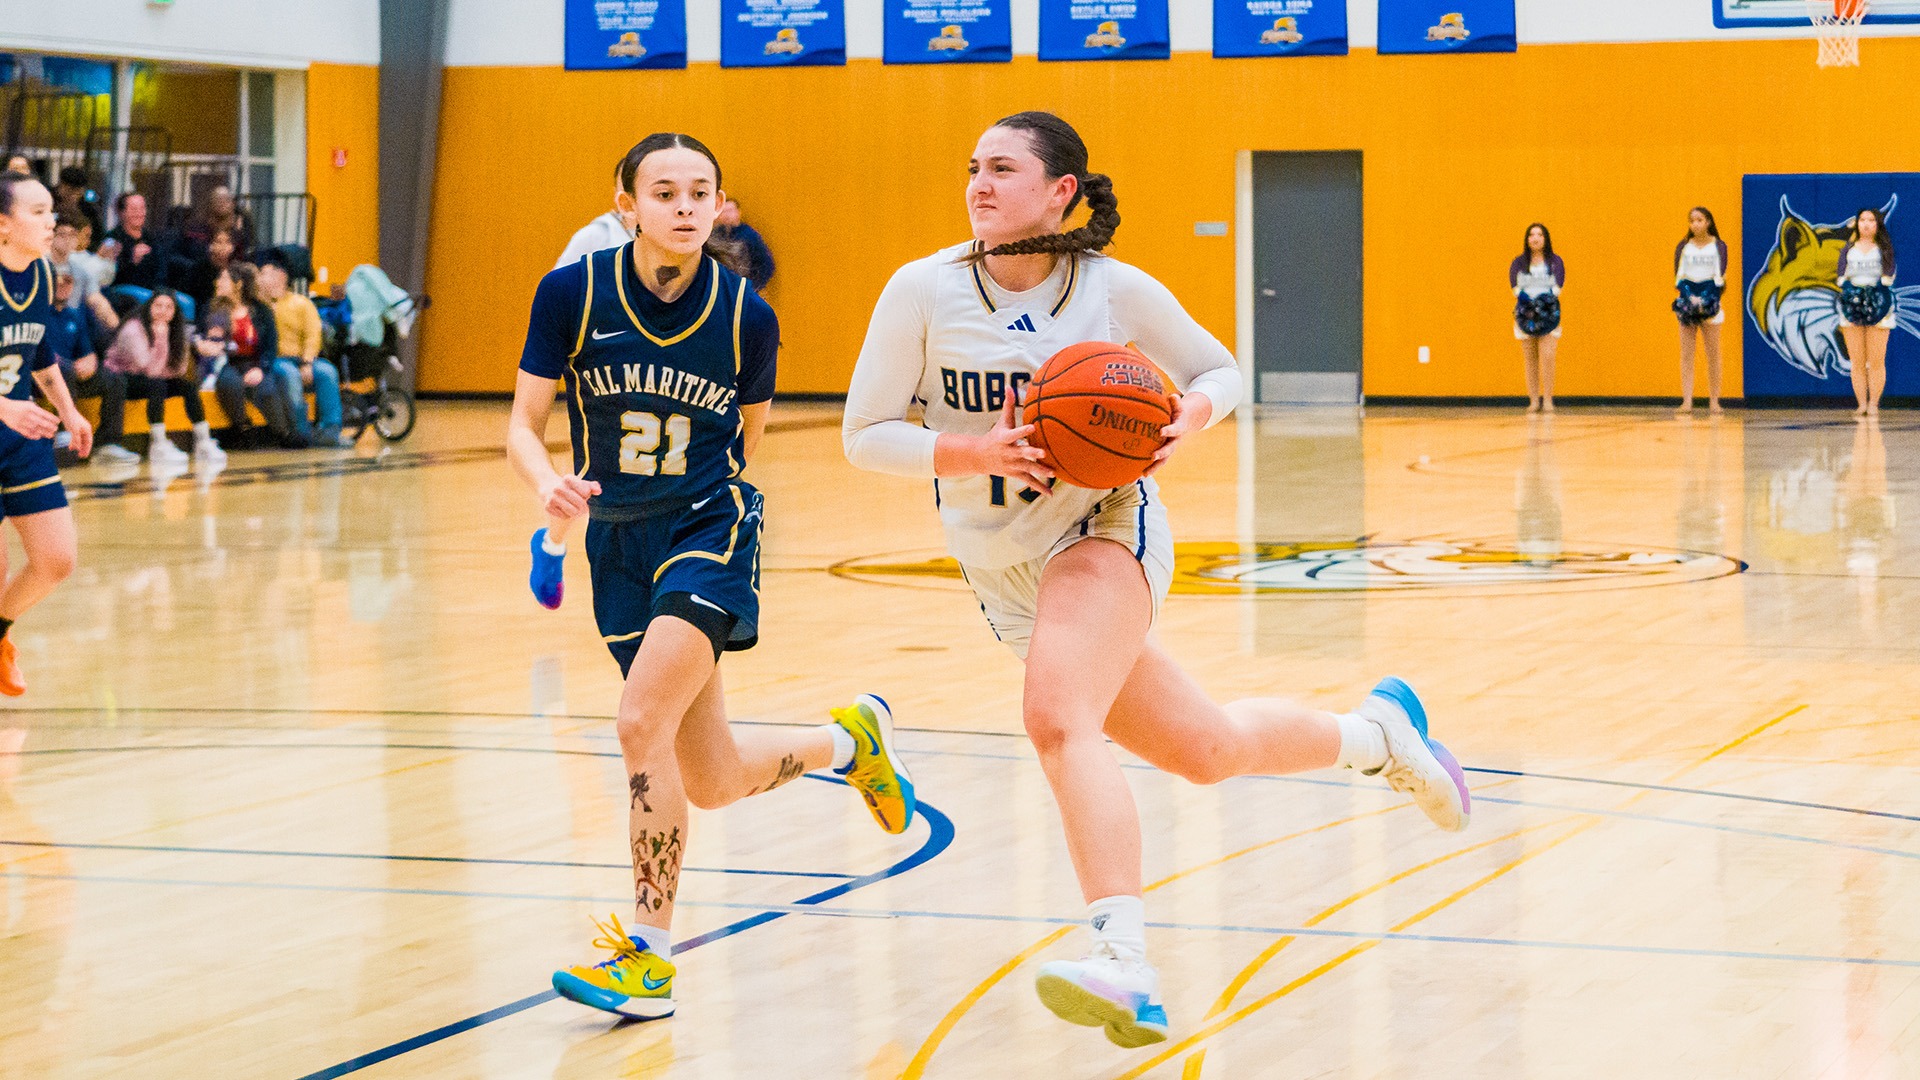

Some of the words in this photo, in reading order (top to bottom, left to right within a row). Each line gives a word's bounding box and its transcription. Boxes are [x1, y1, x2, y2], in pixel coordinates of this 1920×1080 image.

[582, 364, 622, 398] CAL
[622, 363, 737, 416] MARITIME
[619, 410, 692, 477] 21
